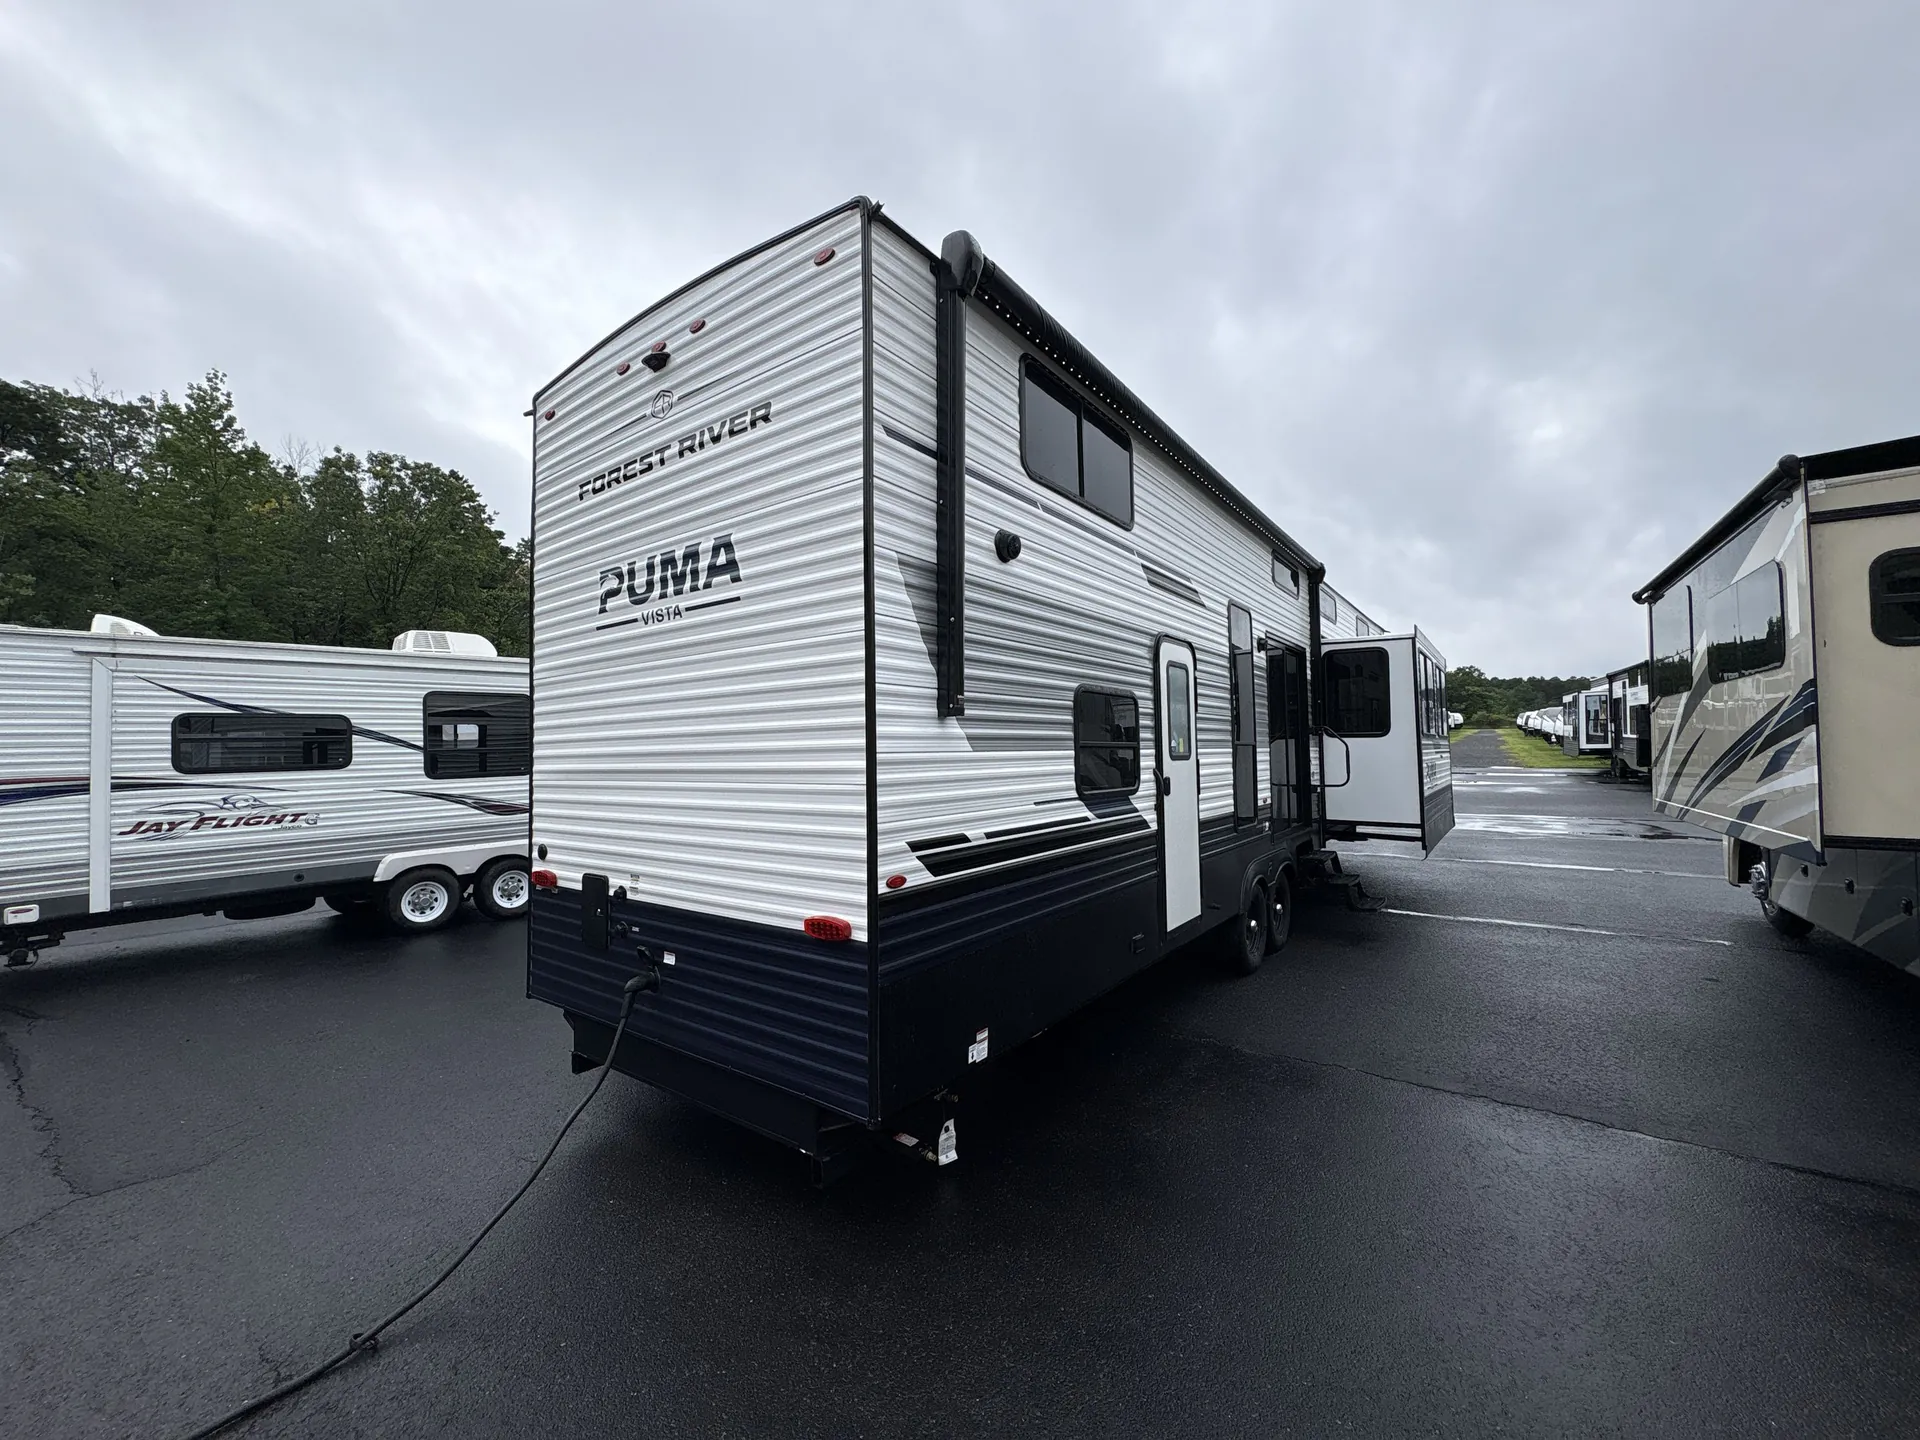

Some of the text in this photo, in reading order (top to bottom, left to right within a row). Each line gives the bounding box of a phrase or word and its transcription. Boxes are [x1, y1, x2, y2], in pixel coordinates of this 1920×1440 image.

[578, 401, 773, 501] FOREST RIVER
[598, 532, 743, 615] PUMA
[641, 604, 683, 626] VISTA
[116, 820, 190, 836] JAY
[189, 812, 308, 831] FLIGHT
